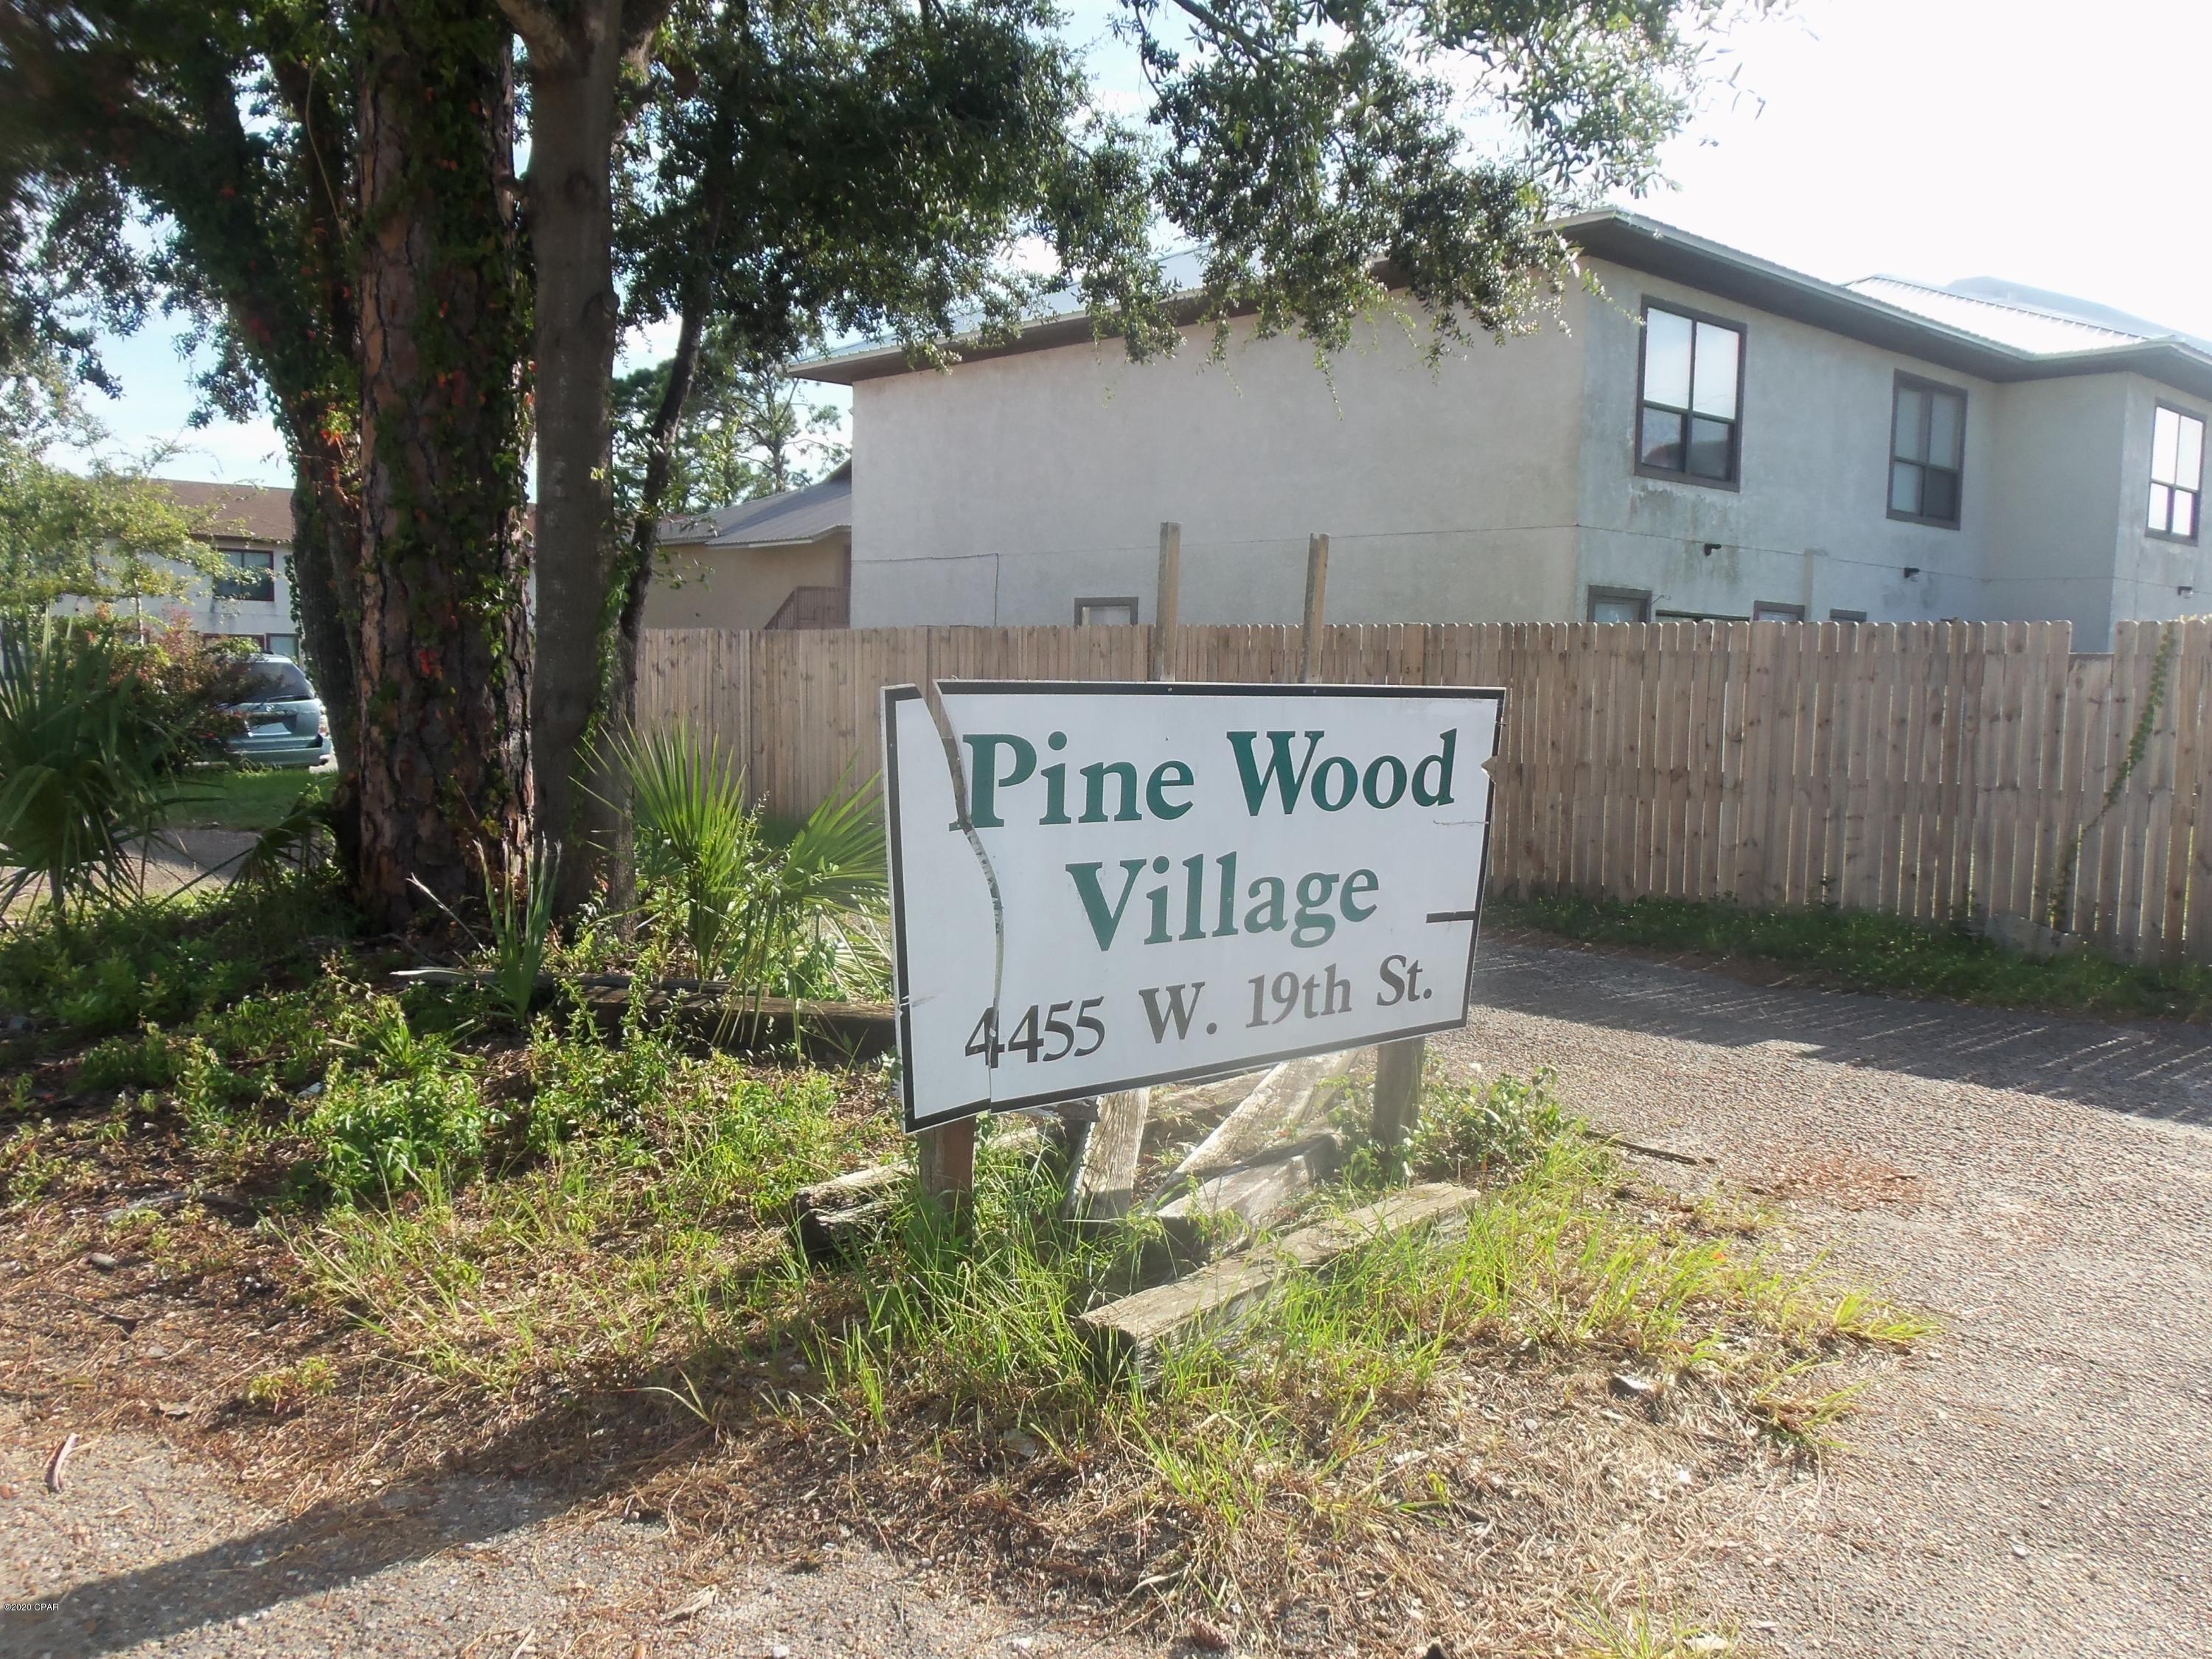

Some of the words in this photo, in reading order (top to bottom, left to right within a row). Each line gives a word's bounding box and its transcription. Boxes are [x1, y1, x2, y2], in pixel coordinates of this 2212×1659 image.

[949, 730, 1195, 832] Pine
[1226, 728, 1457, 817] Wood
[1065, 850, 1380, 952] Village
[965, 995, 1106, 1069] 4455
[1138, 981, 1219, 1044] W.
[1245, 963, 1352, 1029] 19th
[1377, 954, 1433, 1007] St.
